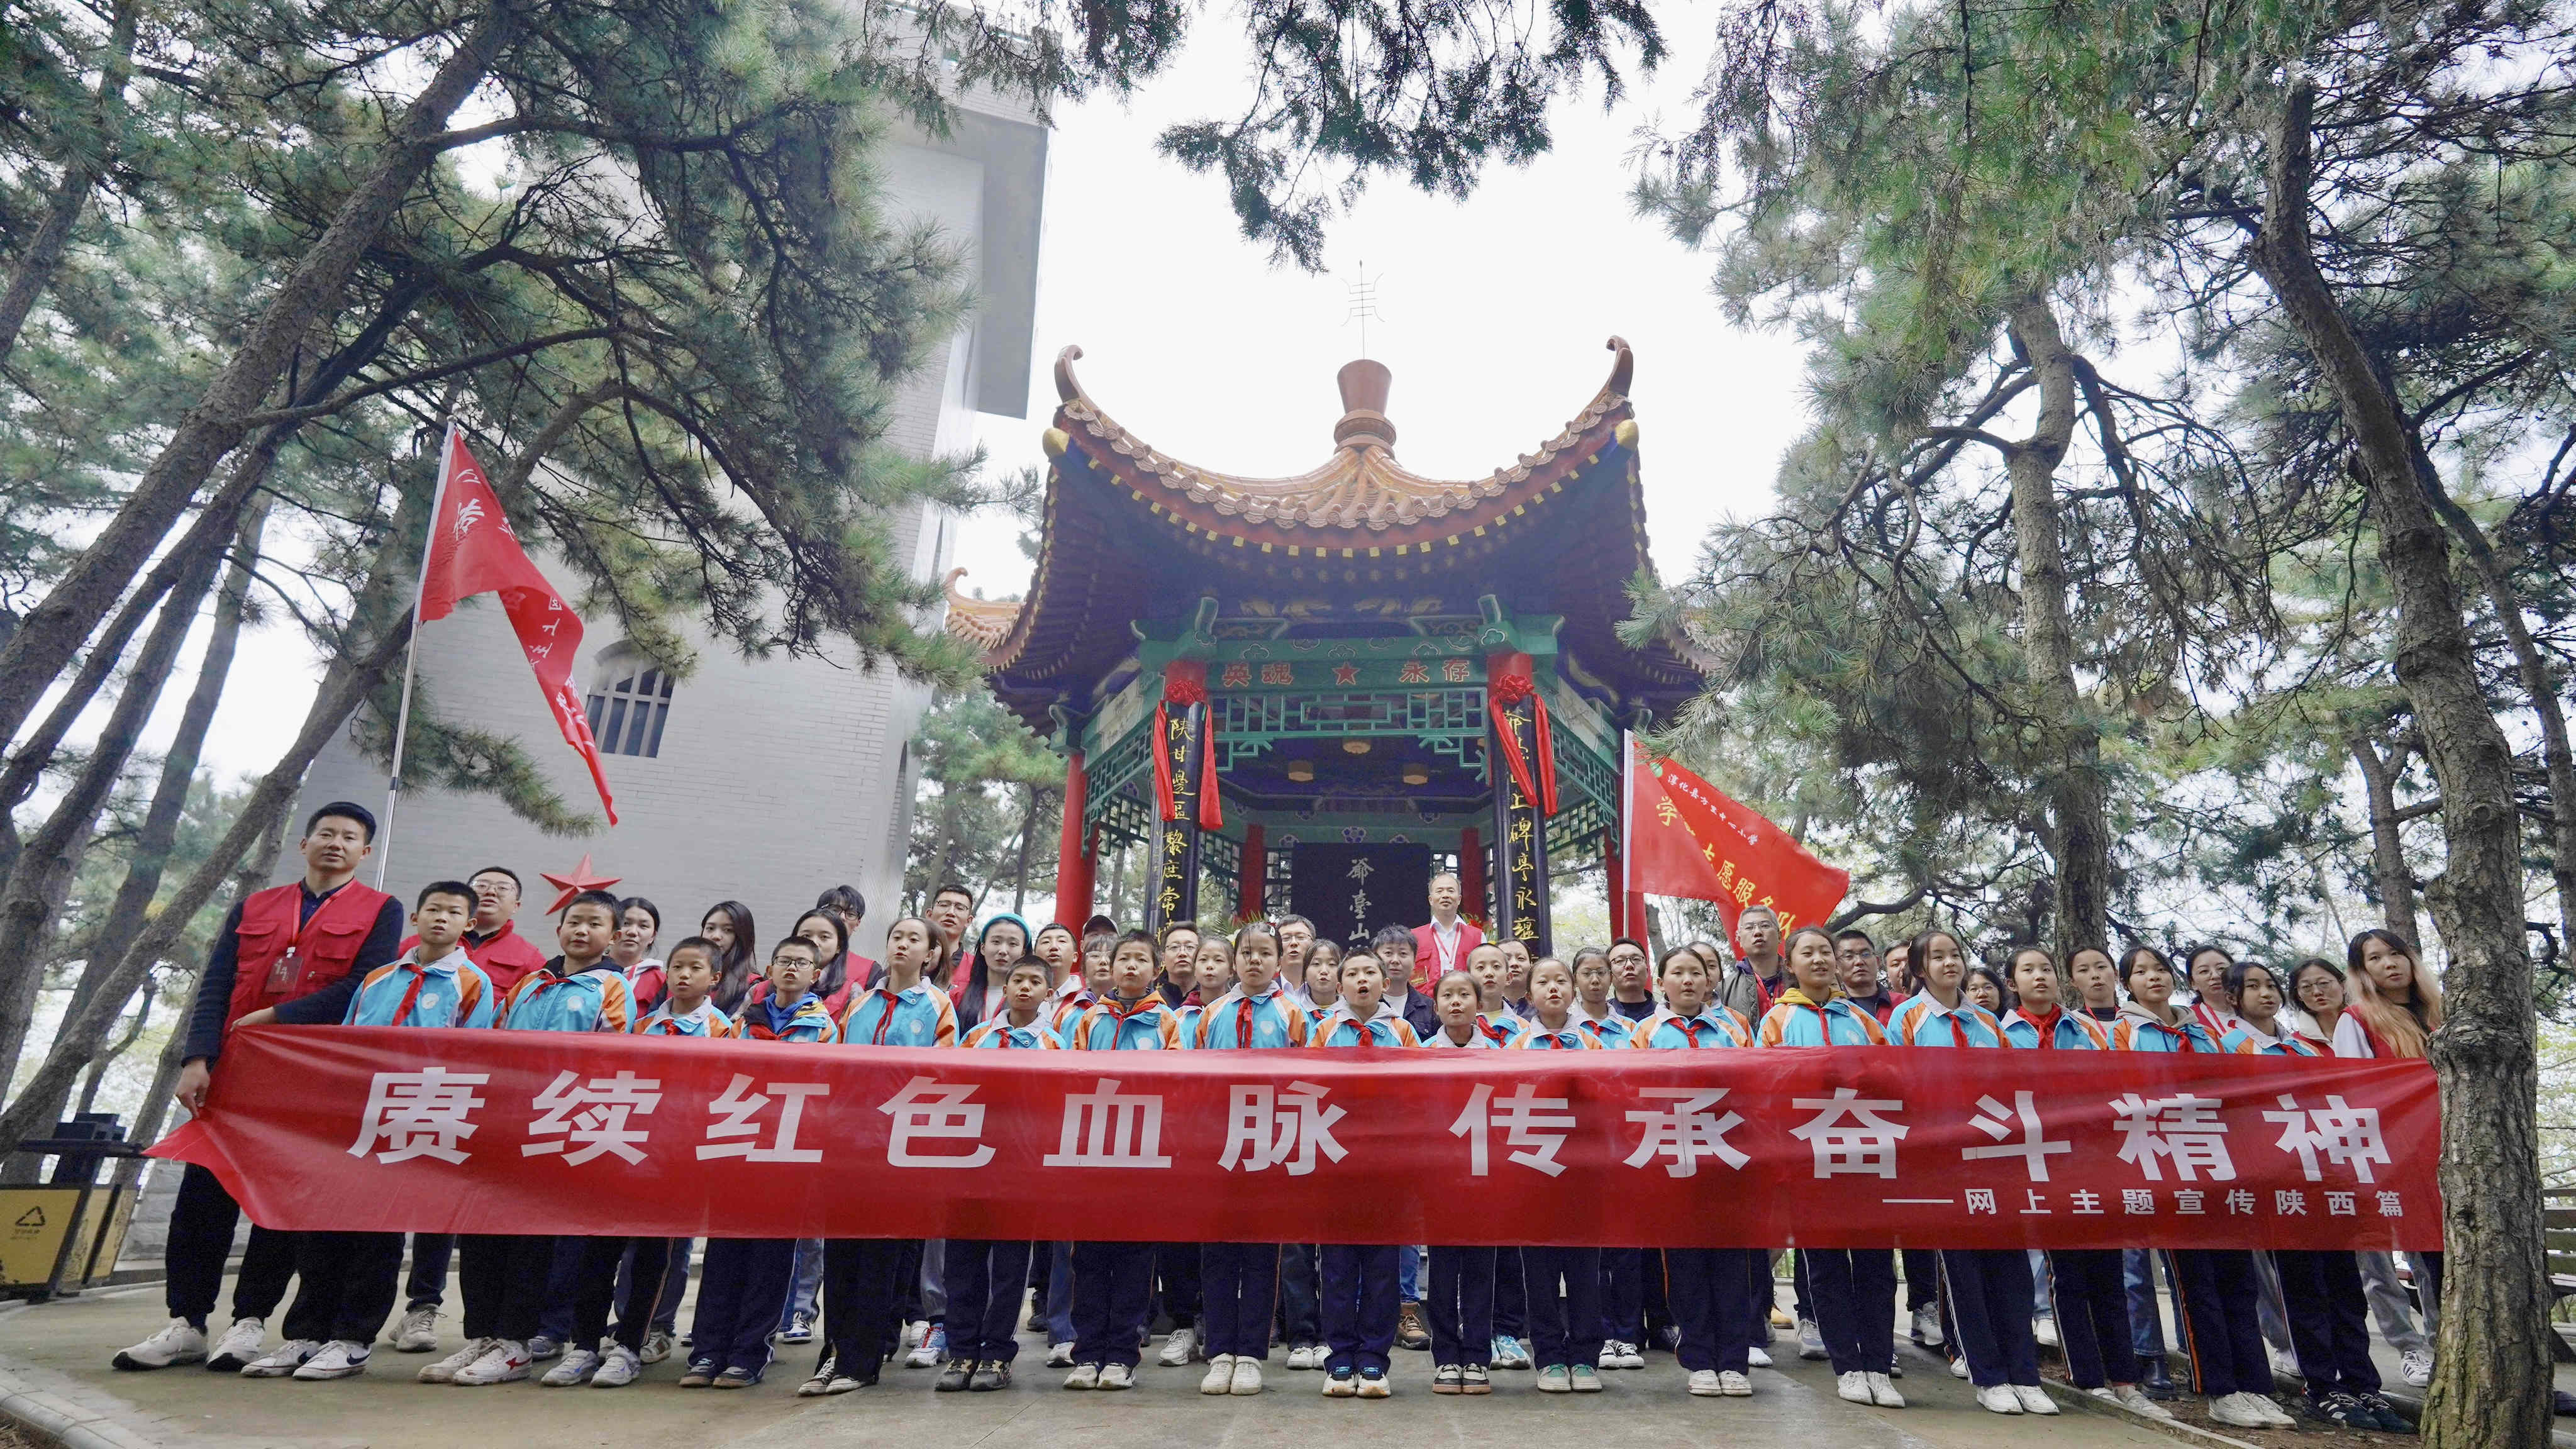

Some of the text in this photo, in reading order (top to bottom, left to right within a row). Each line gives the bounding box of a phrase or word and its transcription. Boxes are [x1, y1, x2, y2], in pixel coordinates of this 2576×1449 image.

[1399, 660, 1470, 682] 永存
[347, 1066, 2393, 1184] 赓续红色血脉 传承奋斗精神
